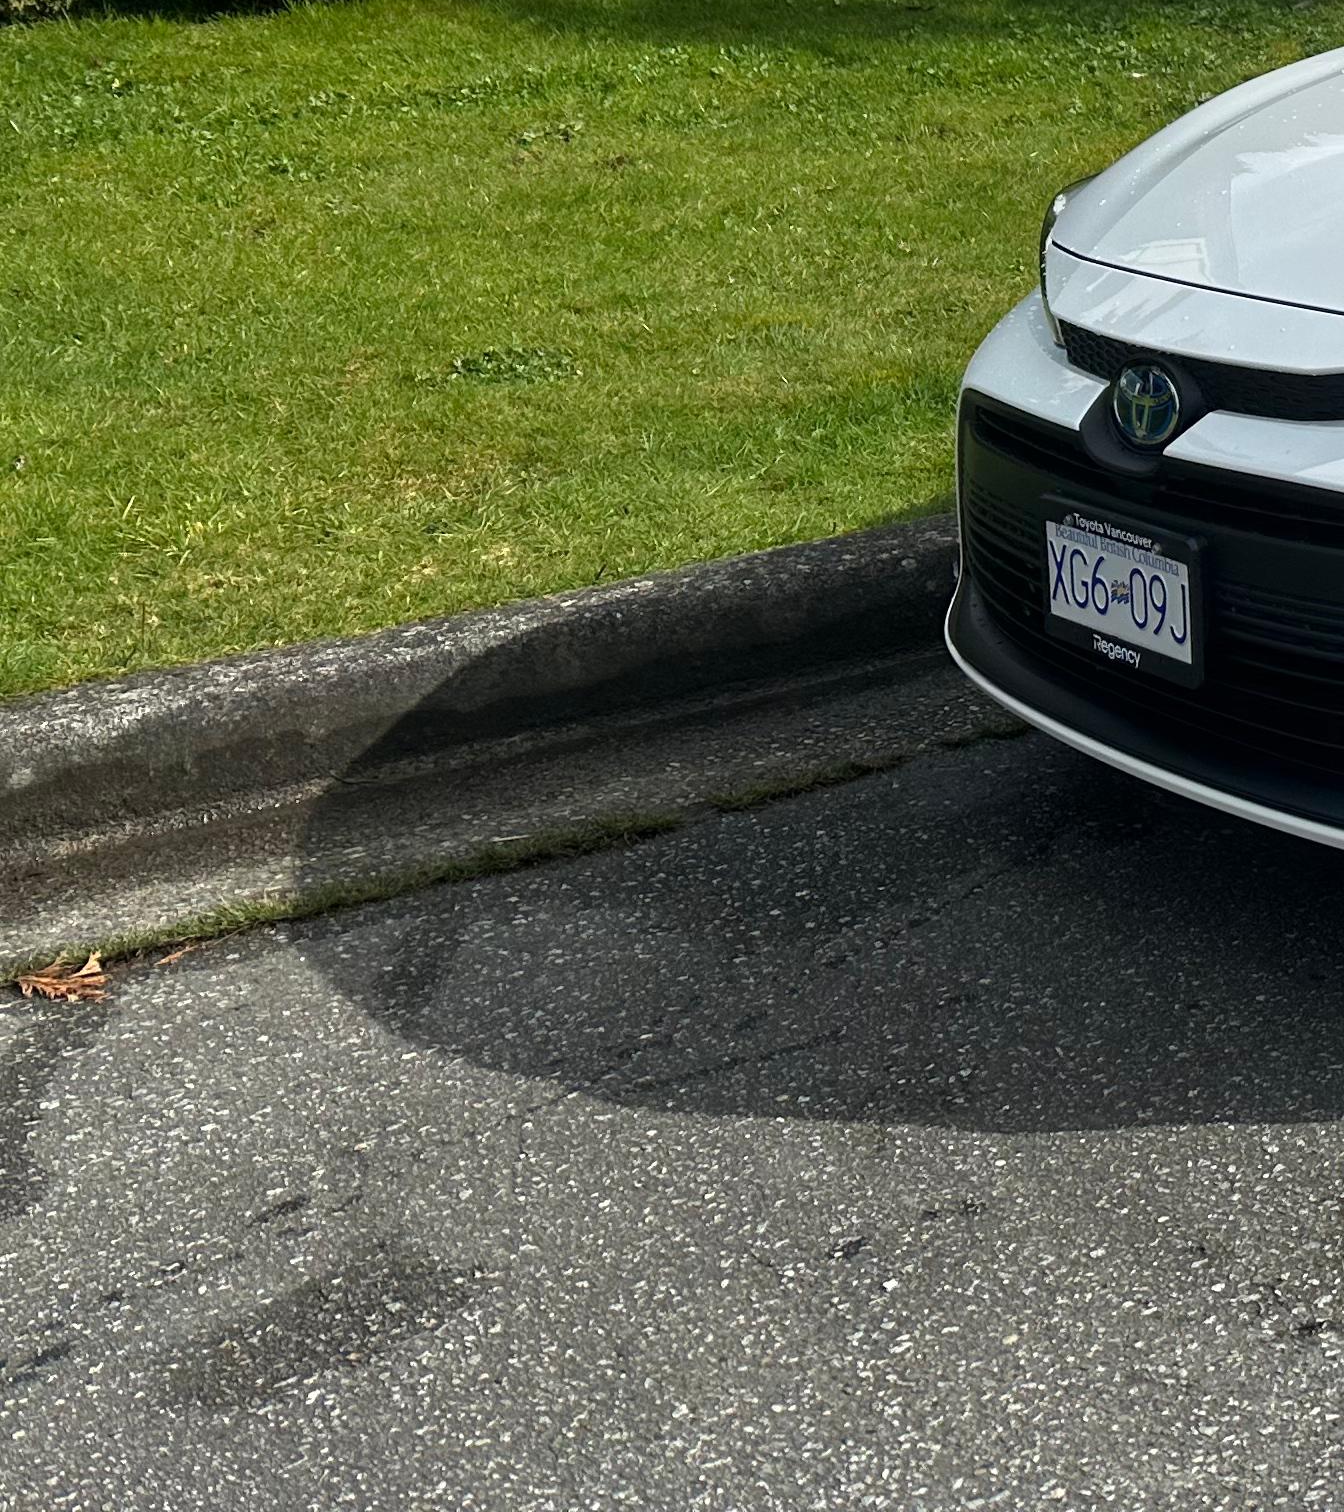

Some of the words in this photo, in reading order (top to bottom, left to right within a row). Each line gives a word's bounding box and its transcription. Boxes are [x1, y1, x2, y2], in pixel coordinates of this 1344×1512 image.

[1073, 512, 1105, 534] Toyota
[1105, 522, 1153, 549] Vancouver
[1133, 548, 1180, 577] Columbia
[1092, 634, 1142, 669] Regency
